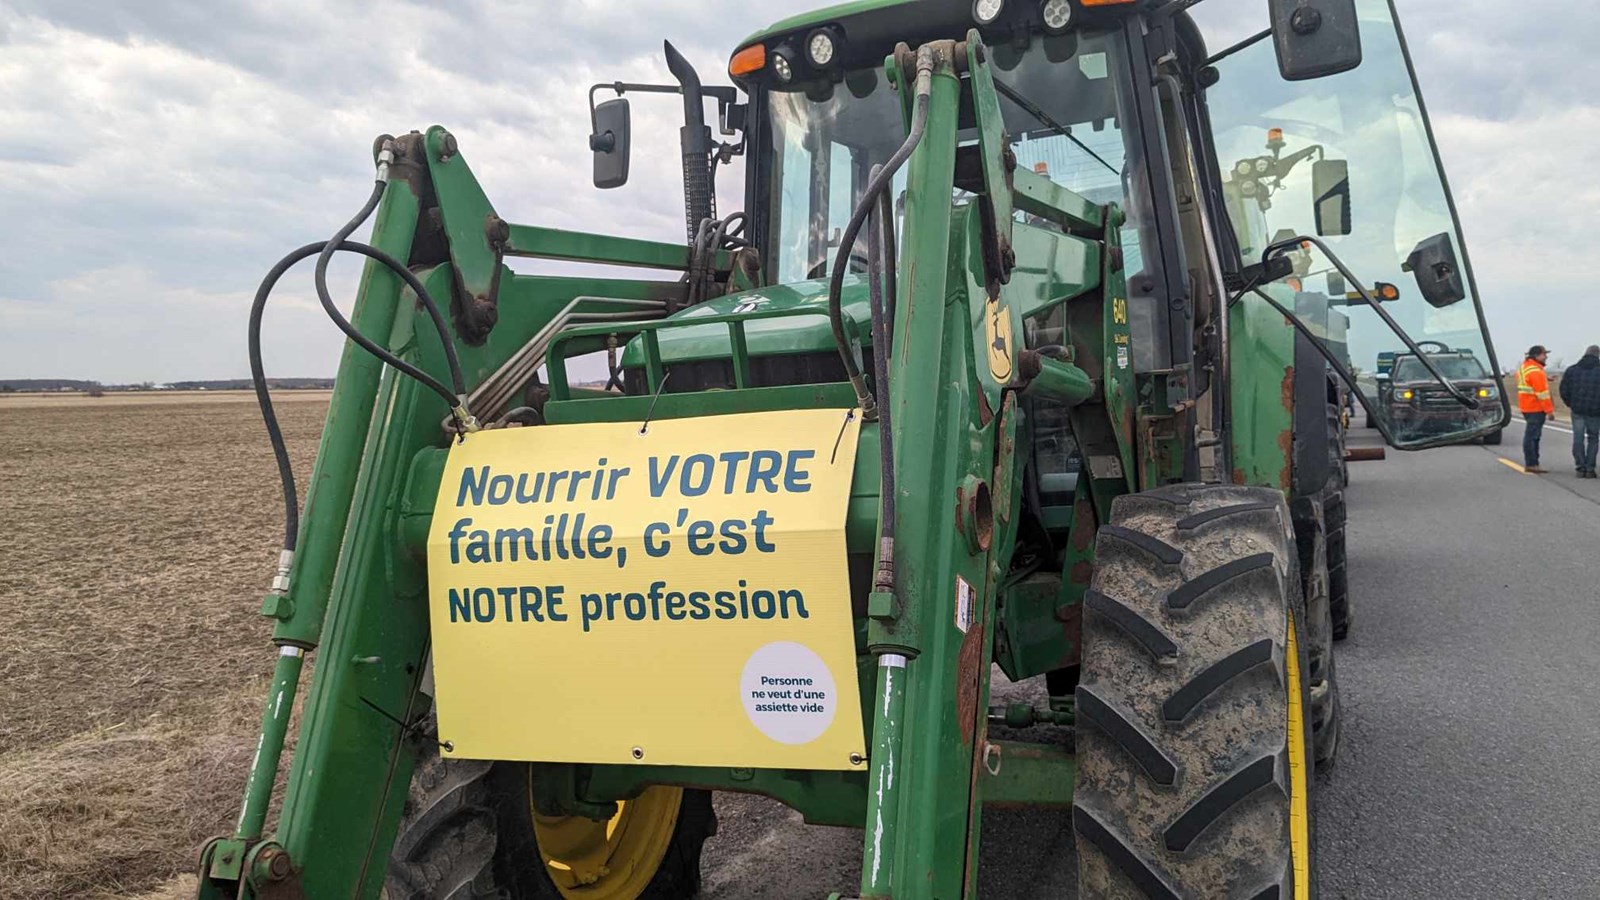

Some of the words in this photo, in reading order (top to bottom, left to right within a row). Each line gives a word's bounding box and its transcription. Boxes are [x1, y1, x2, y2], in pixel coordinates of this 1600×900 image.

[1113, 298, 1126, 324] 640
[455, 457, 631, 507] Nourrir
[648, 449, 816, 498] VOTRE
[448, 512, 628, 569] famille,
[643, 508, 776, 558] c'est
[448, 585, 569, 624] NOTRE
[580, 579, 810, 633] profession
[752, 691, 765, 699] ne
[767, 690, 792, 699] veut
[793, 688, 825, 699] d'une
[761, 676, 813, 686] Personne
[755, 702, 798, 712] assiette
[799, 702, 824, 712] vide
